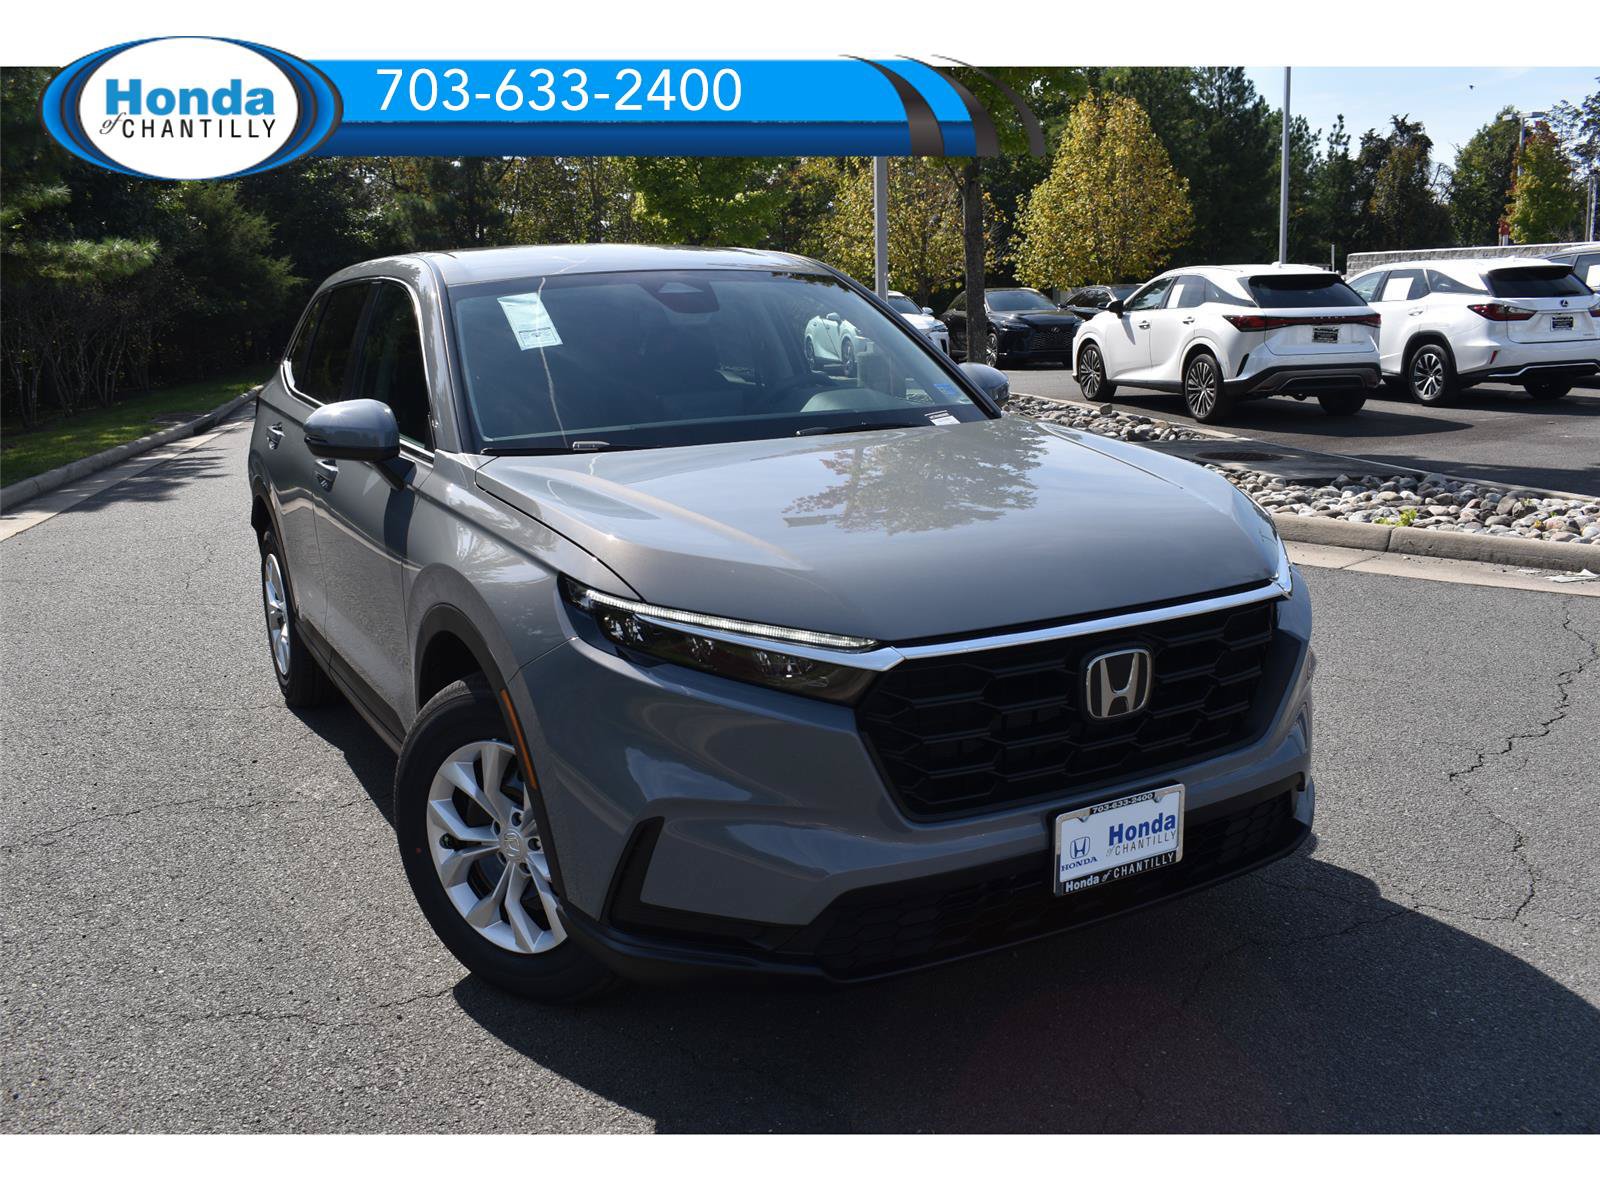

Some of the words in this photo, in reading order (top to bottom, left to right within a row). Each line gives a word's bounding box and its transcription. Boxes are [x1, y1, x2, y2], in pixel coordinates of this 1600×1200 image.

[1092, 793, 1153, 814] 703-633-2400
[1108, 812, 1176, 847] Honda
[1115, 830, 1176, 856] CHANTILLY
[1061, 856, 1098, 872] HONDA
[1065, 875, 1100, 893] Honda
[1102, 870, 1112, 882] of
[1113, 853, 1175, 879] CHANTILLY
